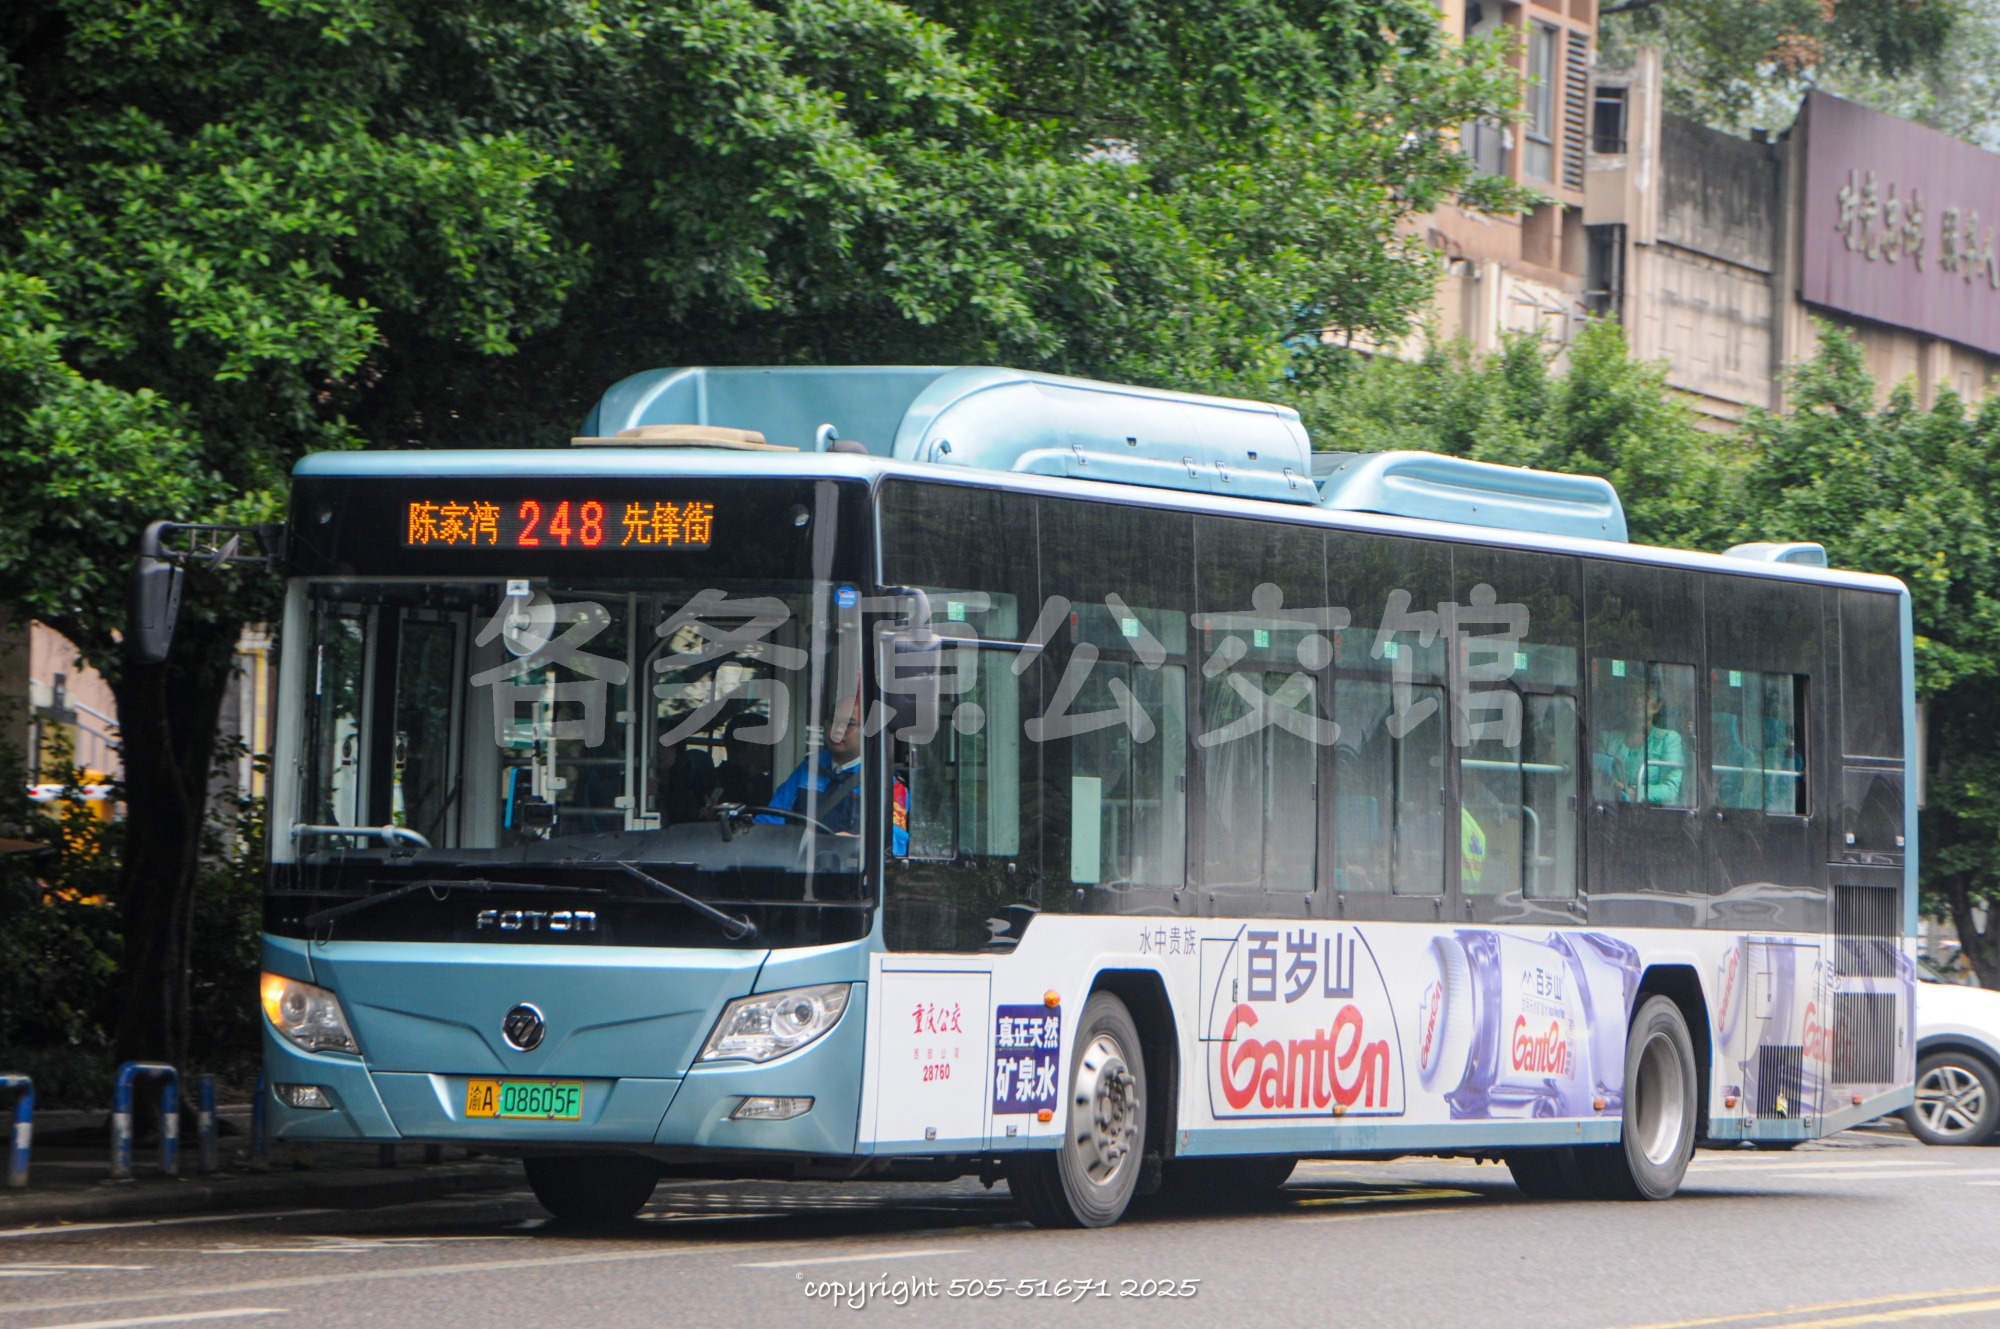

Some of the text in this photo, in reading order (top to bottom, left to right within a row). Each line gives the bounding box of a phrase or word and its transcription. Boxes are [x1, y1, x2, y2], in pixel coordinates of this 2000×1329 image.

[408, 500, 714, 547] 陈家湾 248 先锋街
[476, 908, 597, 932] FOTON
[1138, 925, 1197, 956] 水中贵族
[1246, 928, 1356, 1004] 百岁山
[911, 1002, 963, 1035] 重庆公交
[998, 1015, 1059, 1049] 真正天然
[922, 1063, 951, 1083] 28760
[995, 1055, 1057, 1103] 矿泉水
